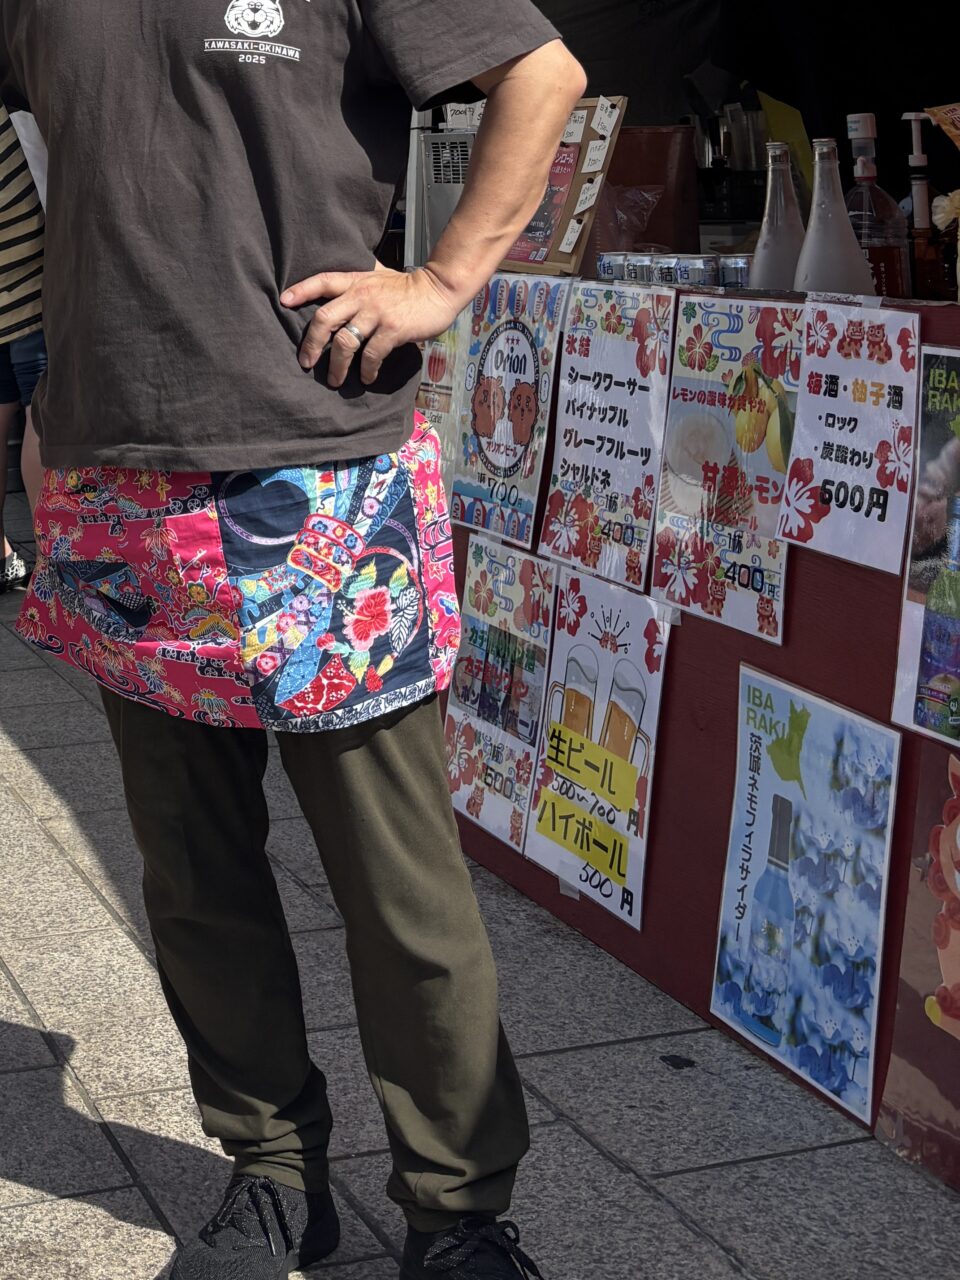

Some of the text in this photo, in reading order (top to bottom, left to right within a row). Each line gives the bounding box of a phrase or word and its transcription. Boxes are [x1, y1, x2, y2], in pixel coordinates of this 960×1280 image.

[204, 40, 300, 59] KAWASAKI-OKINAWA
[238, 54, 266, 64] 2025
[565, 333, 591, 358] 氷結
[494, 346, 527, 376] Orion
[568, 366, 650, 396] シークワーサー
[806, 371, 904, 411] 梅酒・柚子酒
[928, 368, 959, 390] IBA
[565, 398, 629, 428] パイナップル
[672, 386, 767, 417] レモンの酸味が爽やか
[485, 441, 518, 458] オリオンビール
[563, 428, 652, 467] グレープフルーツ
[560, 458, 611, 490] シャルドネ
[746, 684, 775, 714] IBA
[746, 707, 786, 739] RAKI
[547, 727, 616, 795] 生ビール
[538, 799, 627, 878] ハイボール
[735, 732, 762, 942] 茨城ネモフィラサイダー
[578, 861, 634, 917] 500 円
